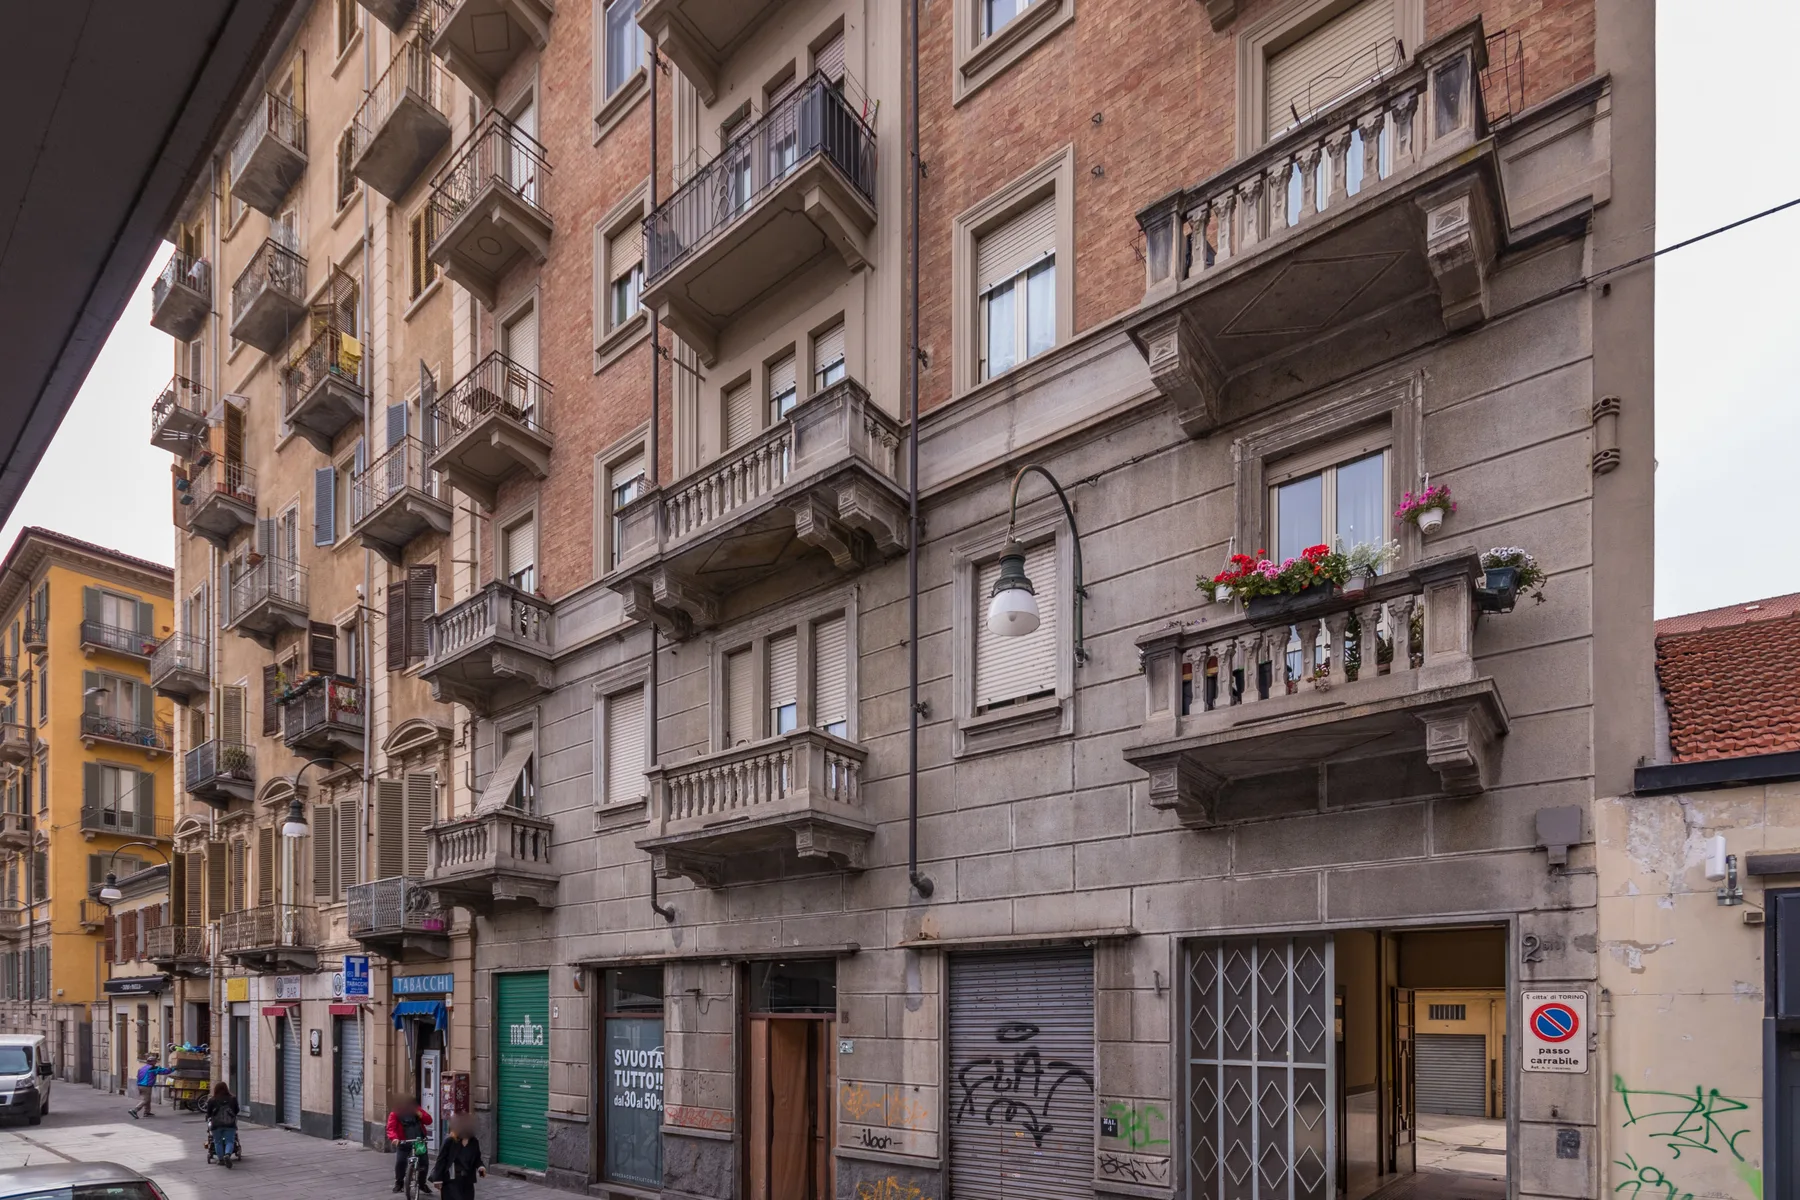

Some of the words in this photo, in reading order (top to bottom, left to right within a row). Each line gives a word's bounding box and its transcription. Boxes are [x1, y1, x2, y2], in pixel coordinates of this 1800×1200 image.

[1522, 933, 1542, 963] 2
[350, 957, 365, 978] T
[397, 975, 450, 993] TABACCHI
[614, 1049, 664, 1069] SVUOTA
[1530, 1057, 1579, 1066] carrabile
[614, 1070, 664, 1091] TUTTO!!
[613, 1094, 625, 1107] dal
[624, 1090, 637, 1108] 30
[636, 1097, 644, 1109] al
